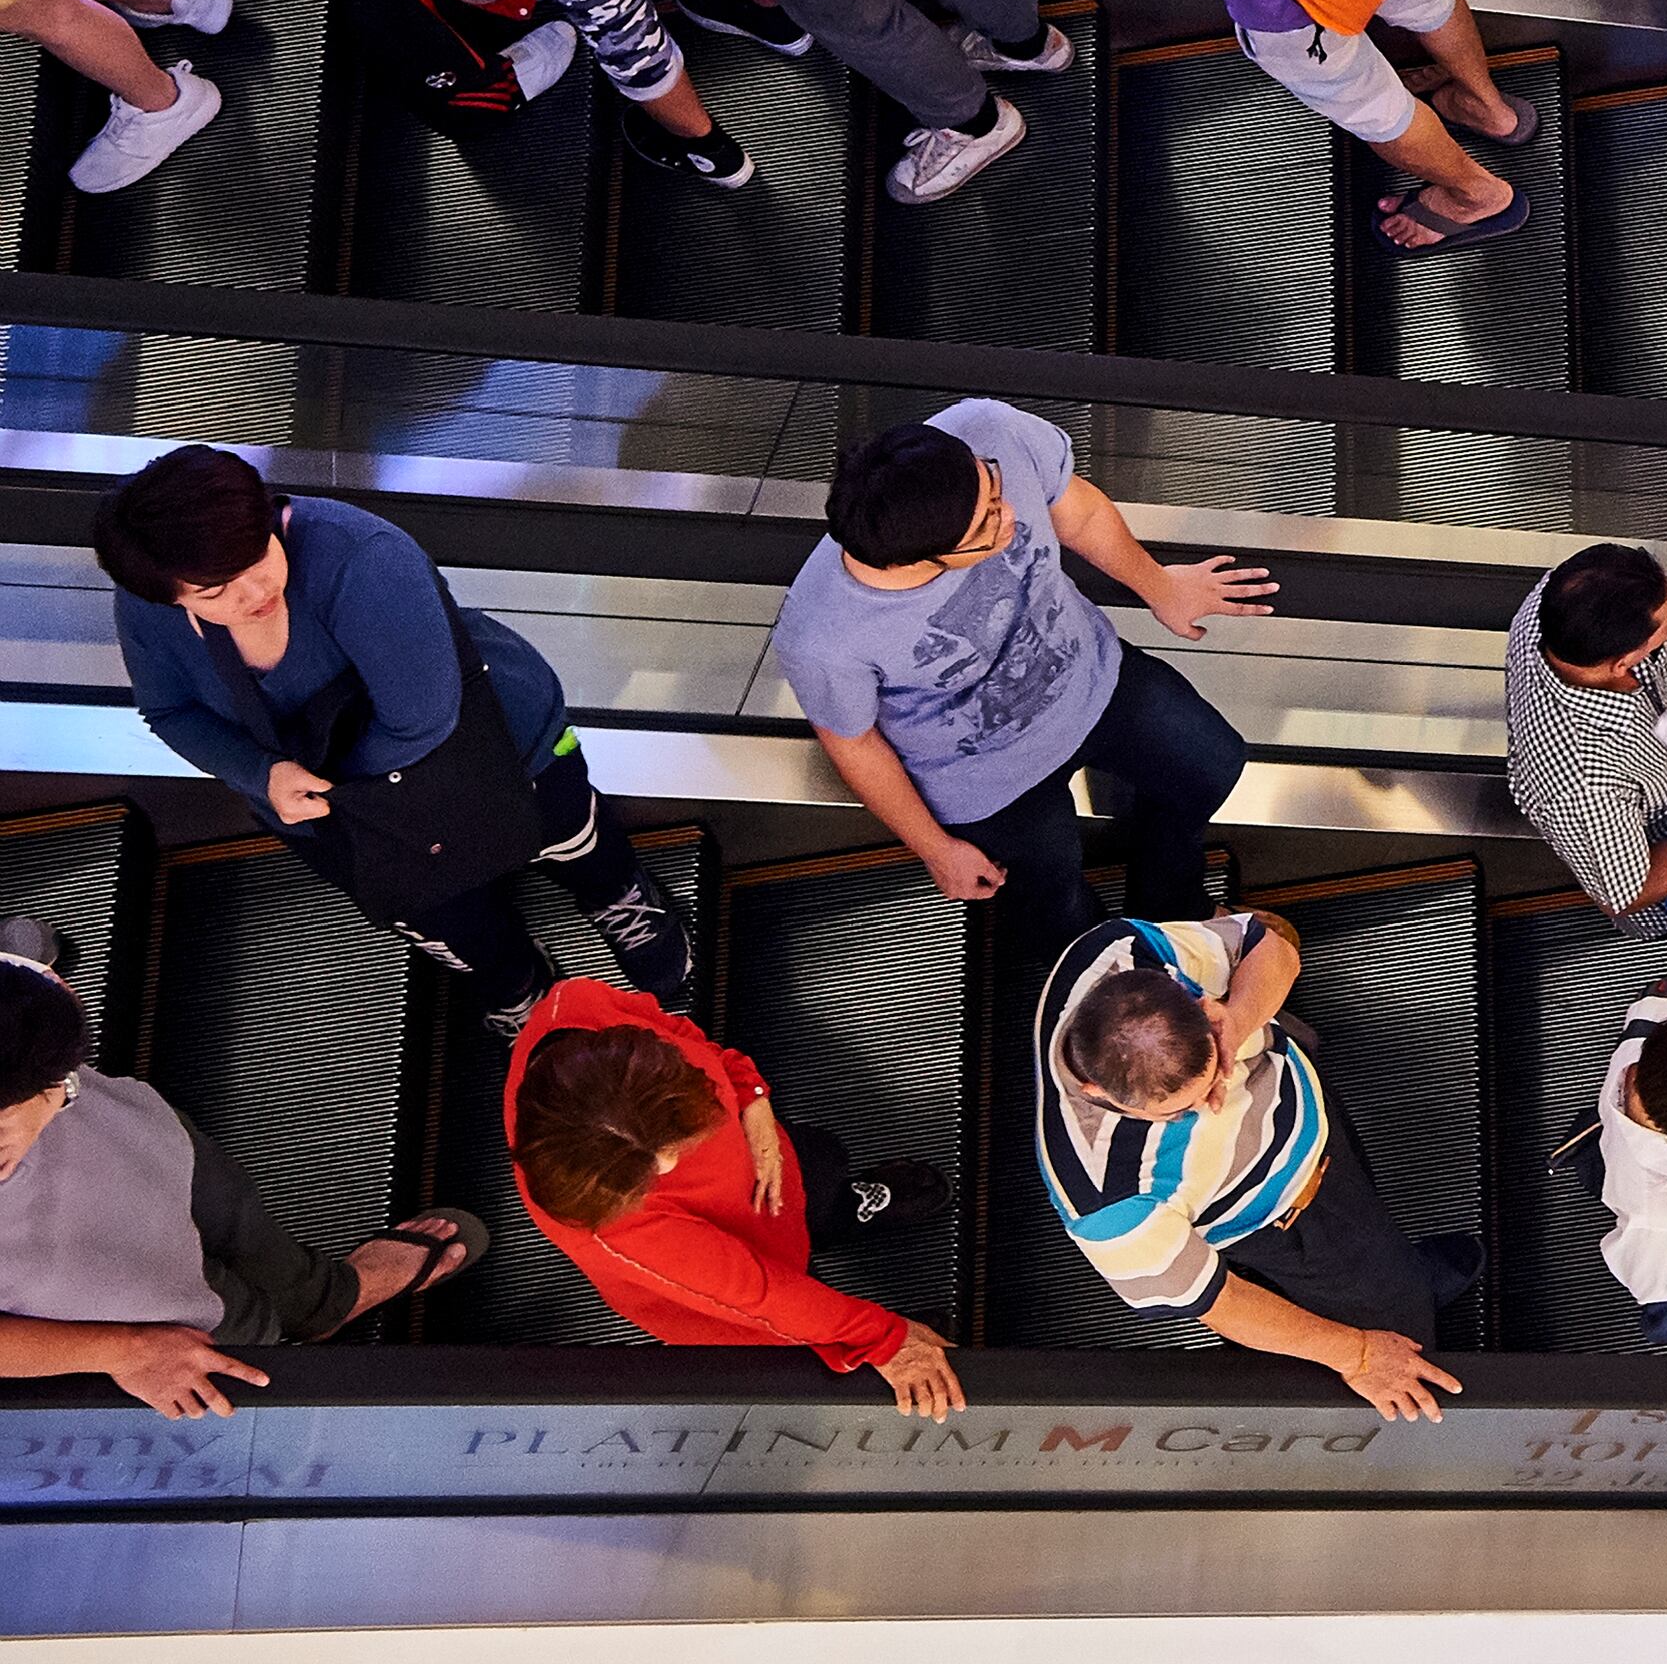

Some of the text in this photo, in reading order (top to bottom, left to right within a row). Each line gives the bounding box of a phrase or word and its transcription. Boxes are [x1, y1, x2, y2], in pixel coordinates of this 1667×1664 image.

[461, 1423, 1384, 1457] PLATINUM M Card
